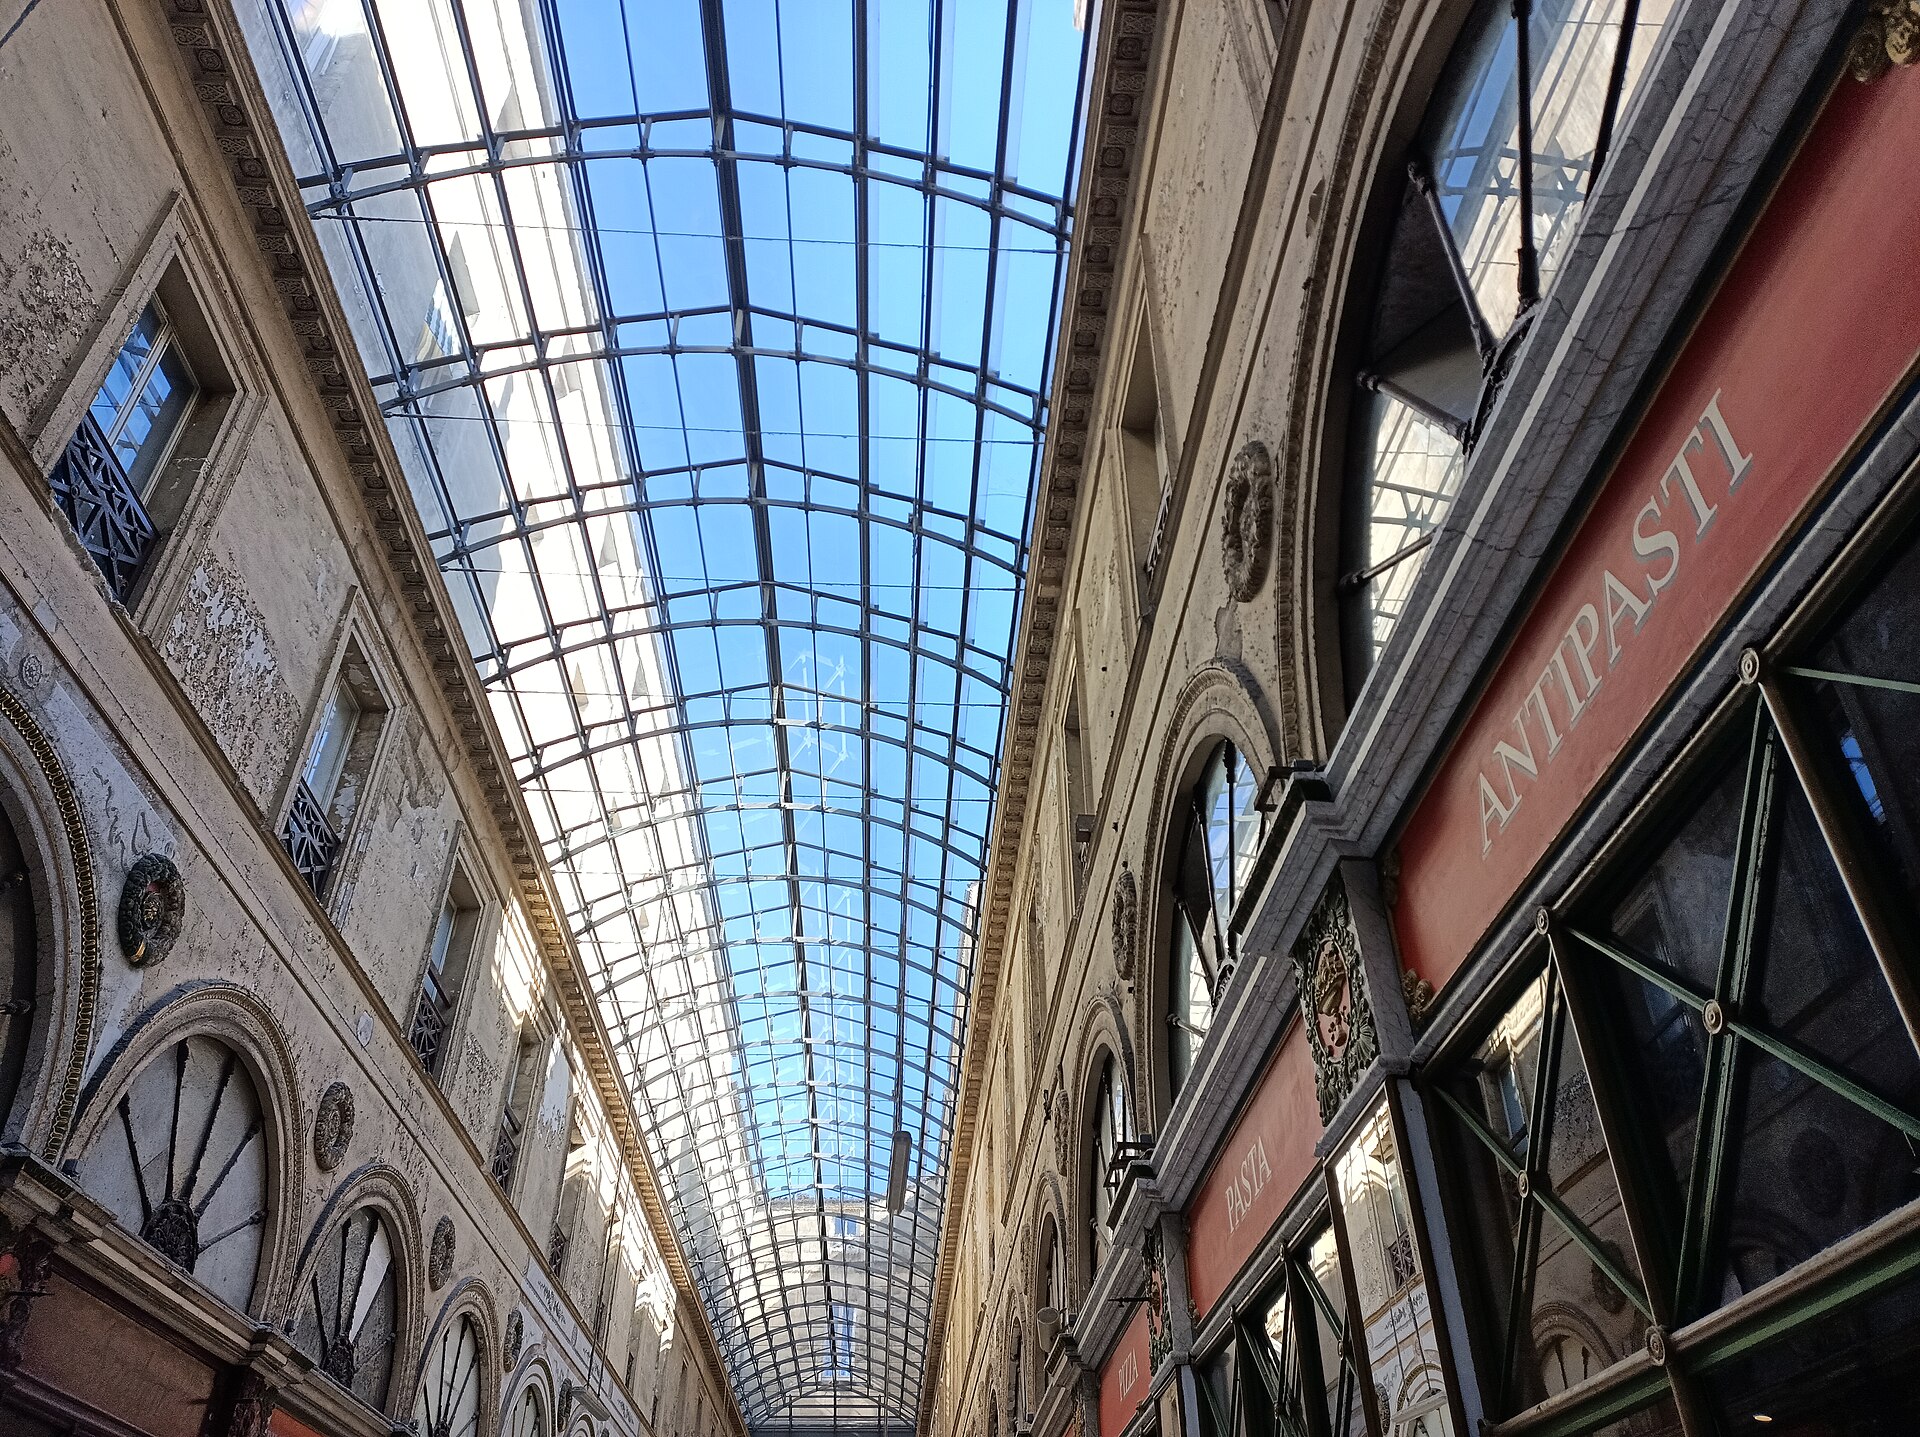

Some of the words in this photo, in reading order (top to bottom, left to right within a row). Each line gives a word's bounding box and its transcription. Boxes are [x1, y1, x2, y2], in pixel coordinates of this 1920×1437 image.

[1478, 388, 1754, 861] ANTIPASTI
[1225, 1135, 1272, 1234] PASTA
[1118, 1347, 1139, 1401] PIZZA
